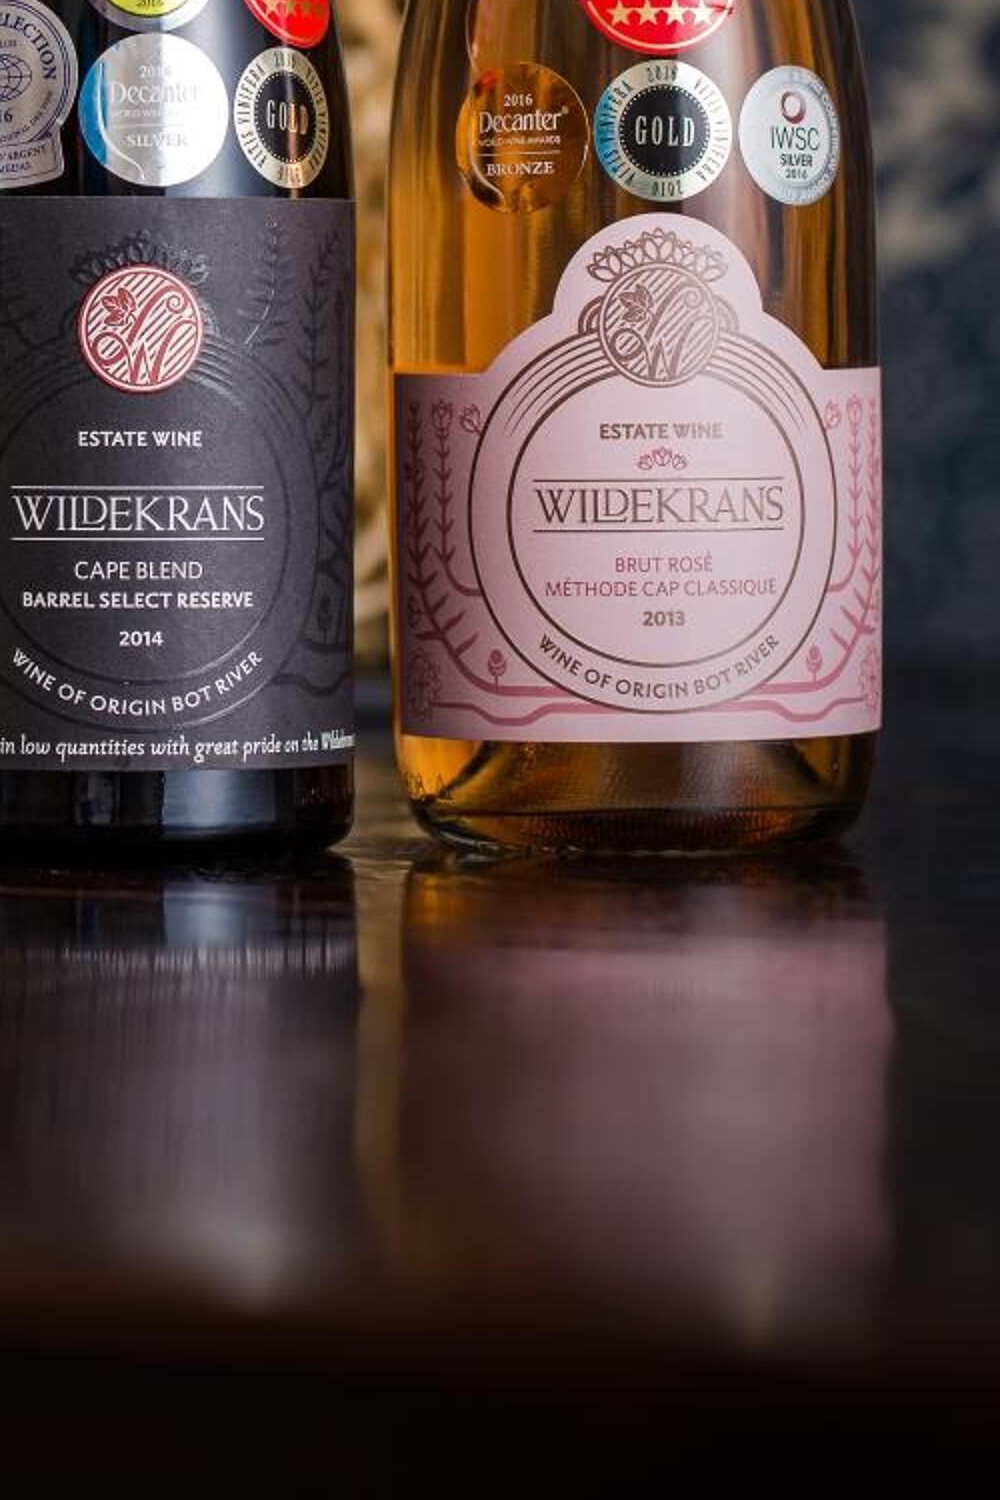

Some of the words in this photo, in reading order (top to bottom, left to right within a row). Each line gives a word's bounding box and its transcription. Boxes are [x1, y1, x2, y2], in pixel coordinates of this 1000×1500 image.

[503, 93, 534, 107] 2016
[266, 99, 310, 136] GOLD
[479, 108, 562, 134] Decanter
[124, 133, 189, 148] SILVER
[635, 115, 696, 147] GOLD
[769, 126, 820, 151] IWSC
[486, 161, 556, 177] BRONZE
[779, 153, 813, 167] SILVER
[78, 431, 147, 447] ESTATE
[152, 431, 203, 447] WINE
[600, 423, 669, 439] ESTATE
[673, 422, 725, 439] WINE
[11, 495, 265, 531] WILDEKRANS
[536, 485, 784, 524] WILDEKRANS
[74, 561, 130, 580] CAPE
[135, 561, 203, 580] BLEND
[615, 556, 662, 574] BRUT
[668, 553, 714, 573] ROSÉ
[545, 577, 638, 597] MÉTHODE
[643, 581, 680, 597] CAP
[684, 577, 778, 597] CLASSIQUE
[23, 591, 95, 608] BARREL
[99, 591, 173, 609] SELECT
[177, 591, 254, 608] RESERVE
[642, 611, 685, 627] 2013
[119, 631, 165, 647] 2014
[540, 633, 584, 676] WINE
[584, 667, 613, 689] OF
[615, 679, 689, 699] ORIGIN
[694, 668, 731, 695] BOT
[736, 634, 780, 677] RIVER
[12, 647, 58, 692] WINE
[58, 683, 87, 706] OF
[89, 694, 166, 717] ORIGIN
[171, 684, 212, 713] BOT
[213, 650, 264, 696] RIVER
[0, 736, 16, 755] in
[21, 733, 51, 756] low
[55, 736, 146, 764] quantities
[150, 734, 190, 756] with
[192, 740, 238, 764] great
[242, 732, 281, 764] pride
[283, 739, 299, 754] on
[301, 730, 320, 751] the
